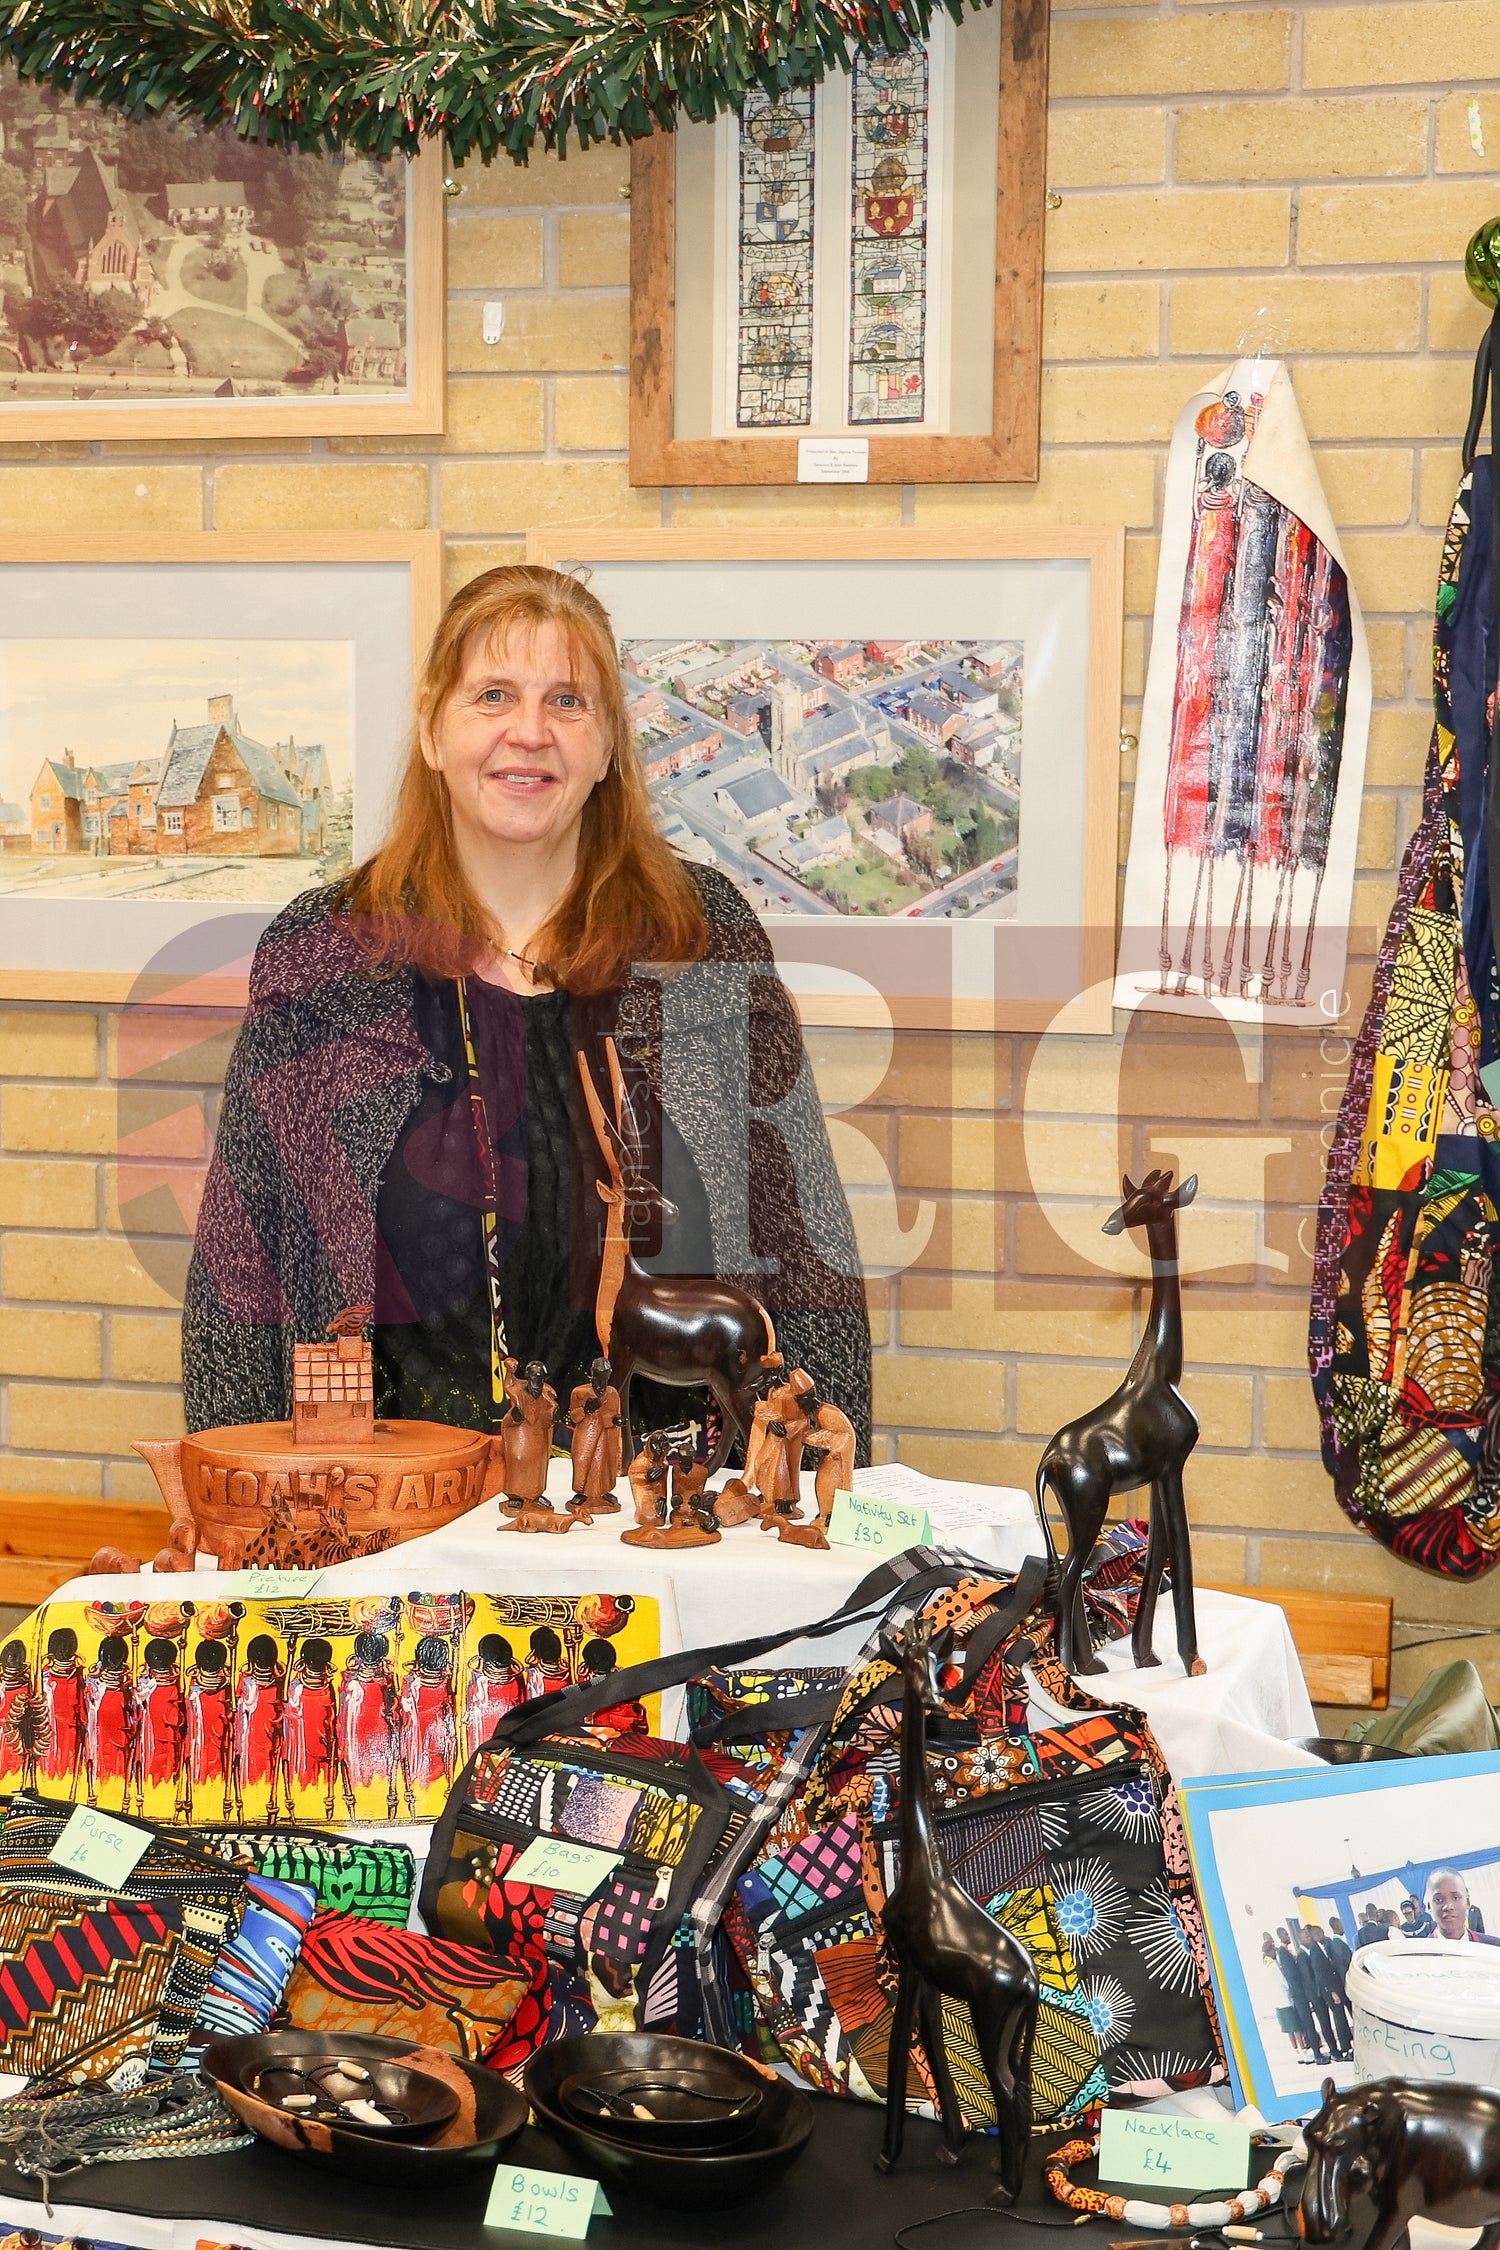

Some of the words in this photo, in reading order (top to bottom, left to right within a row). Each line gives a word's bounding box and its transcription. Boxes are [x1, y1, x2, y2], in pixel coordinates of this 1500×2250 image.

[199, 1465, 378, 1511] NOAH'S
[848, 1496, 894, 1527] Nativity
[896, 1510, 917, 1526] Set
[854, 1522, 883, 1544] £30
[248, 1571, 308, 1583] Picture
[253, 1583, 282, 1594] £12
[80, 1814, 124, 1853] Purse
[69, 1843, 88, 1861] £6
[542, 1842, 595, 1864] Bags
[527, 1860, 560, 1878] £10
[1124, 2118, 1220, 2145] Necklace
[1143, 2147, 1172, 2173] £4
[511, 2173, 579, 2202] Bowls
[511, 2200, 549, 2227] £12
